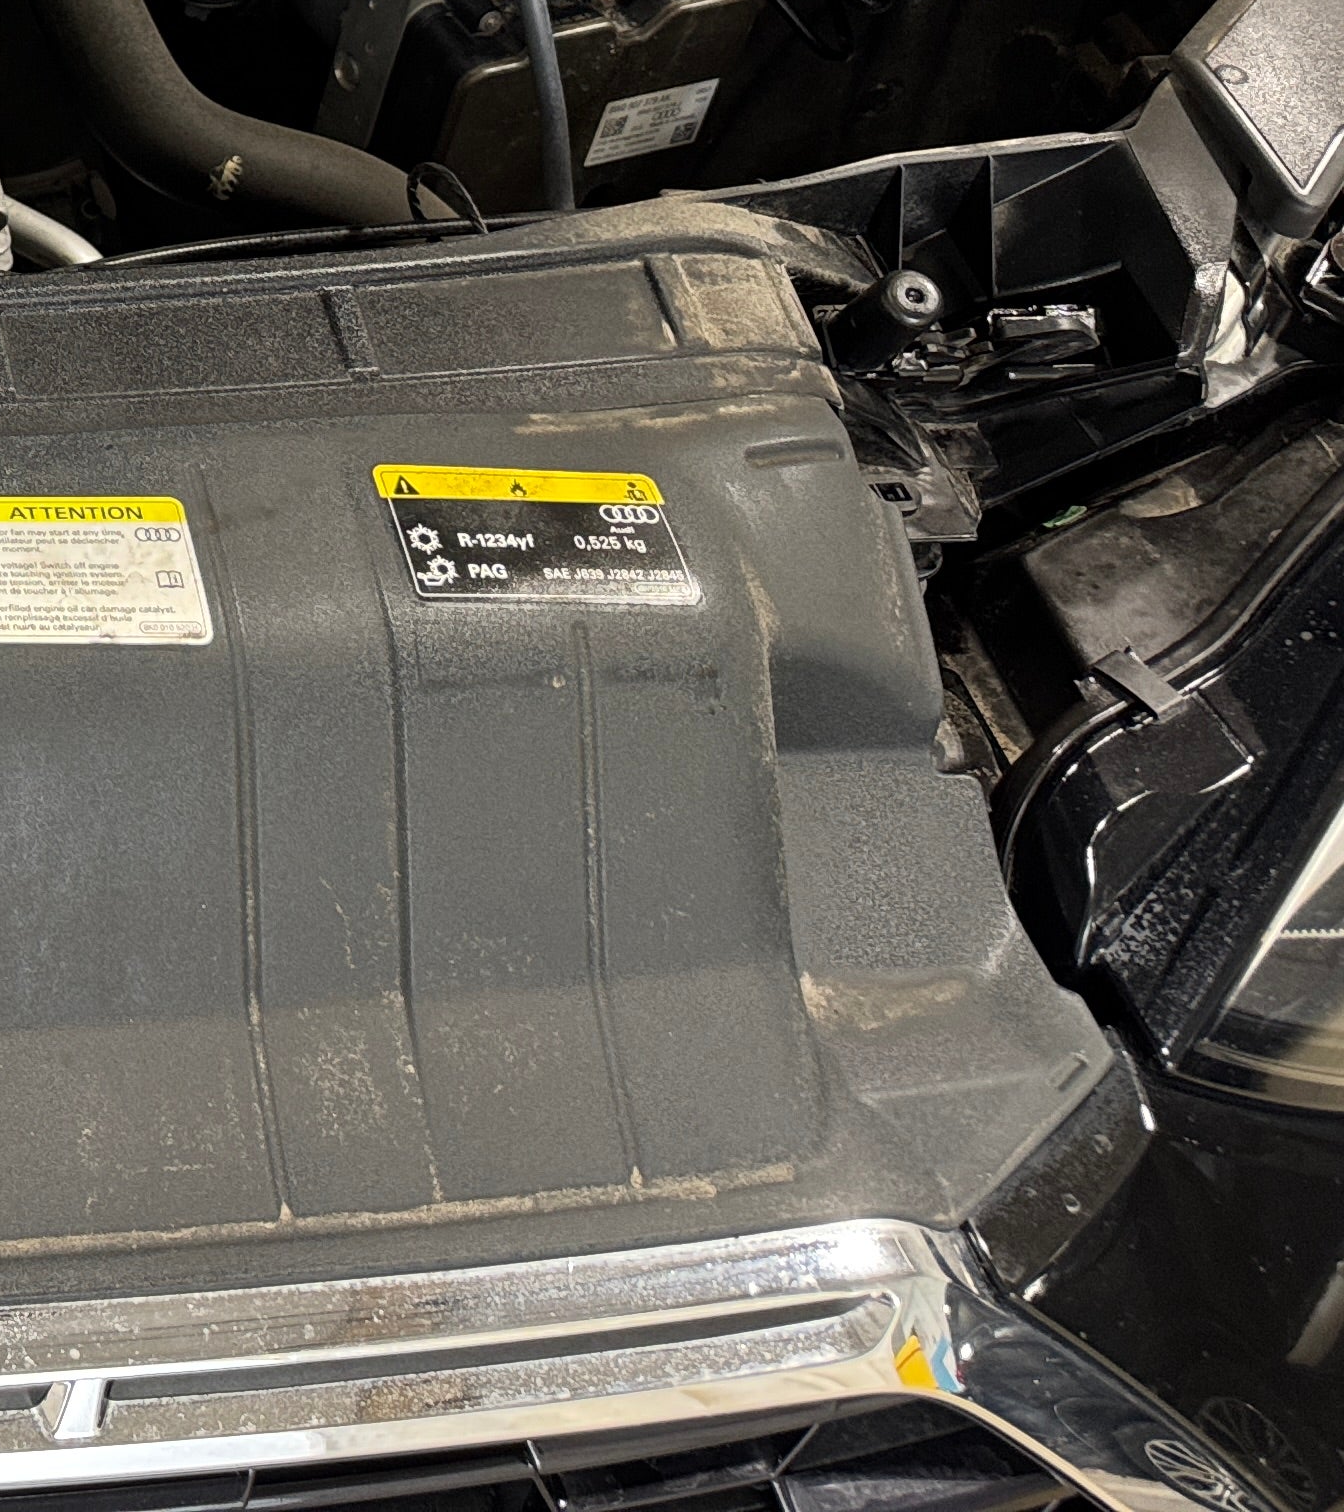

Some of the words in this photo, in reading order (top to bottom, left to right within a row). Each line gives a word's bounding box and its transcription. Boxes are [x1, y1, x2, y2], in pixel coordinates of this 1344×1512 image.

[8, 505, 145, 520] ATTENTION
[10, 528, 26, 537] fan
[27, 529, 47, 538] may
[48, 529, 70, 537] start
[82, 529, 99, 538] any
[609, 525, 636, 534] Audi
[35, 537, 57, 546] peut
[456, 532, 535, 552] R-1234yf
[573, 535, 622, 552] 0,525
[624, 536, 647, 554] kg
[40, 561, 72, 570] Switch
[73, 561, 86, 570] off
[88, 562, 120, 571] engine
[10, 570, 51, 579] touching
[52, 570, 88, 580] ignition
[467, 563, 509, 580] PAG
[542, 567, 572, 580] SAE
[606, 568, 646, 581] J2842
[91, 579, 125, 587] moteur
[9, 587, 22, 595] de
[23, 587, 59, 595] toucher
[33, 604, 65, 614] engine
[67, 604, 79, 613] oil
[85, 605, 98, 613] can
[99, 604, 137, 614] damage
[4, 613, 61, 623] remplissage
[12, 622, 36, 631] nuire
[38, 623, 51, 631] au
